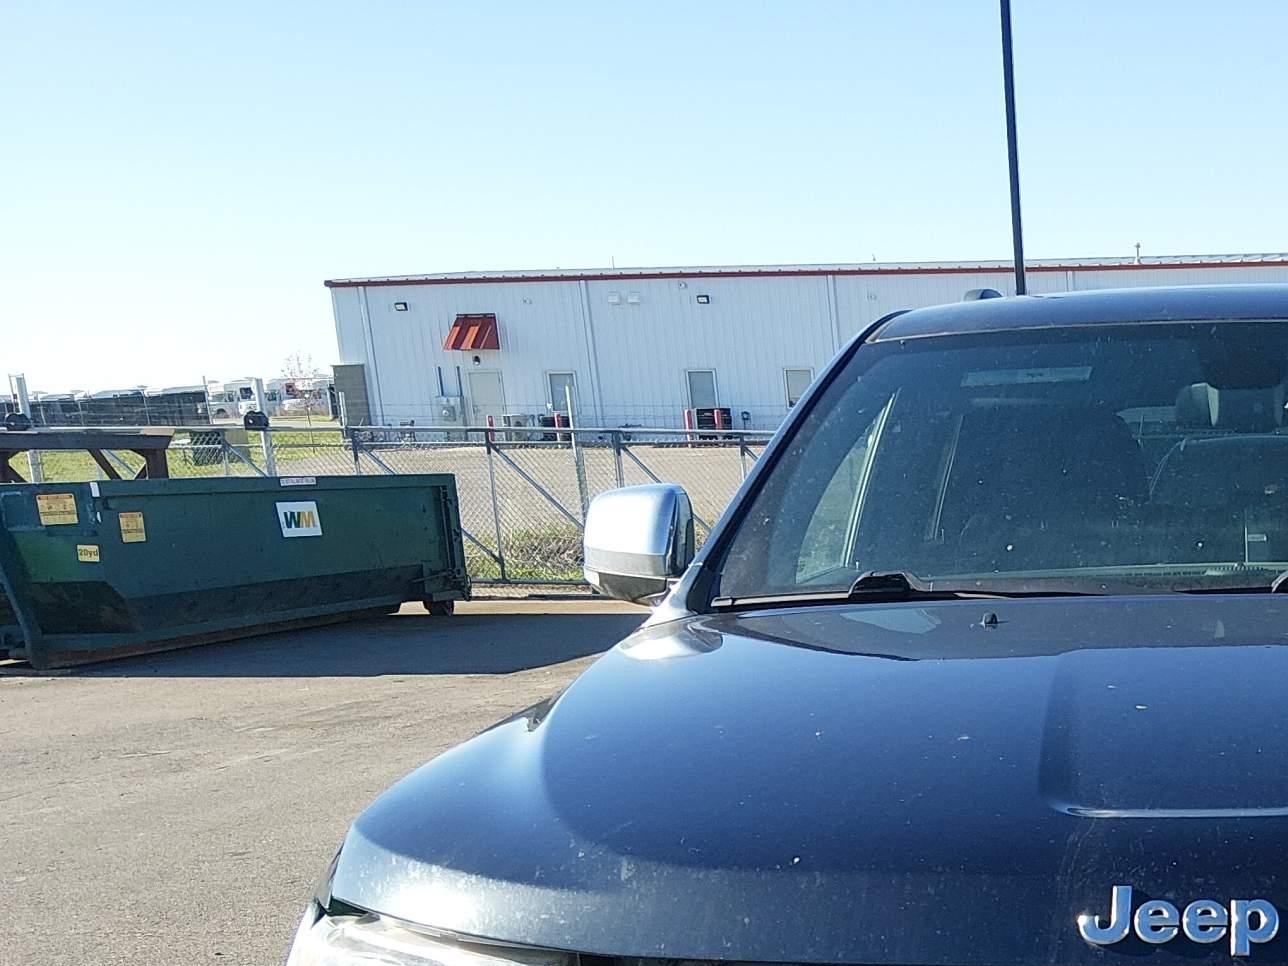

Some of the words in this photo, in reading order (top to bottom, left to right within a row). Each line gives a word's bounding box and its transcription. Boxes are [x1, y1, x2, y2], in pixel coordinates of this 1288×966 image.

[283, 511, 316, 529] WM
[78, 548, 99, 559] 20yd
[1077, 885, 1279, 957] Jeep
